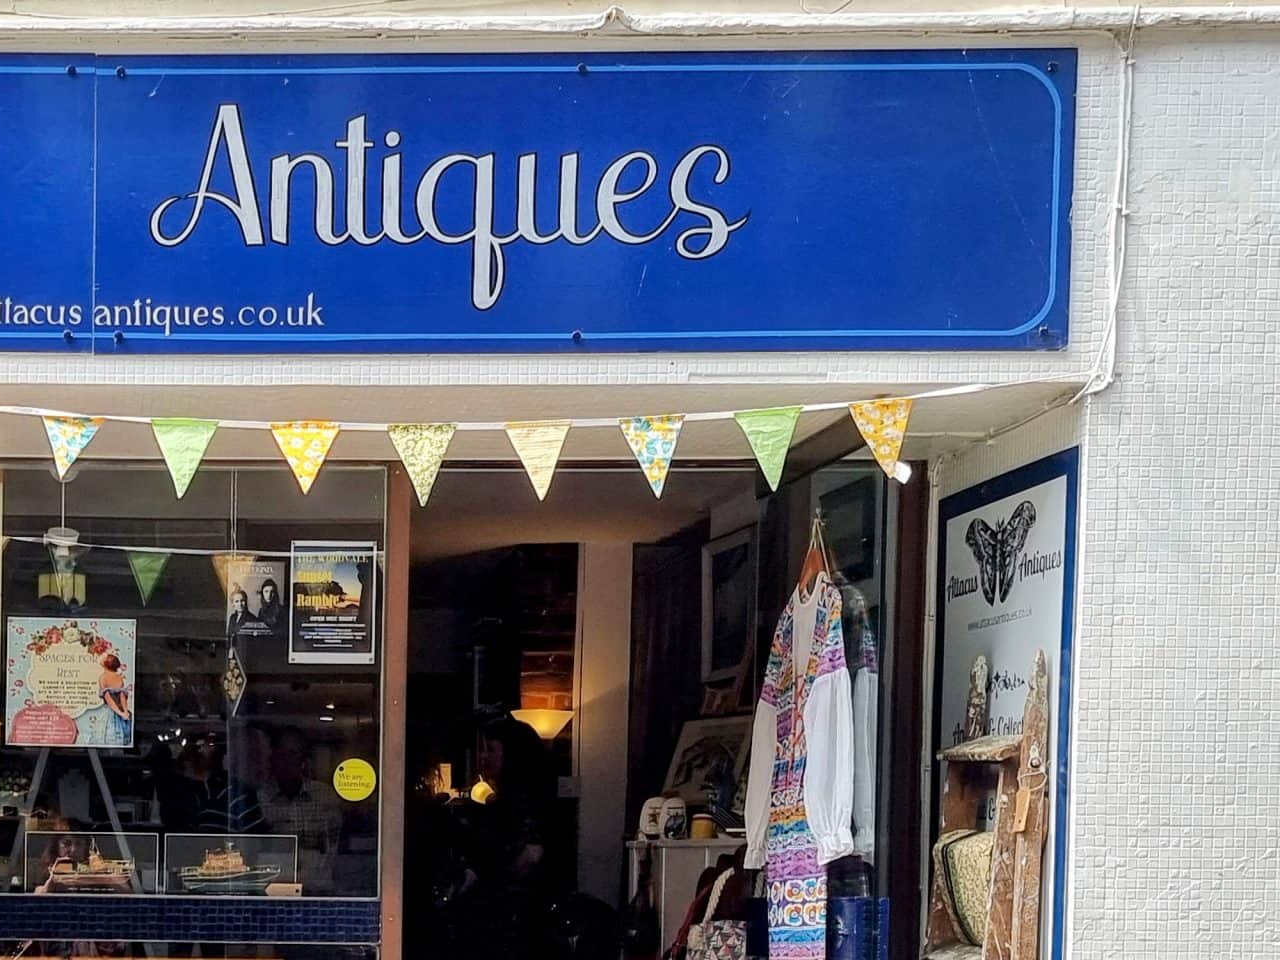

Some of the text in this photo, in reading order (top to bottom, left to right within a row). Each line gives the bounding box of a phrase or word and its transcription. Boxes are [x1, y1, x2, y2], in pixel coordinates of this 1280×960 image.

[150, 104, 748, 310] Antiques
[947, 549, 1062, 603] Attacus Antiques
